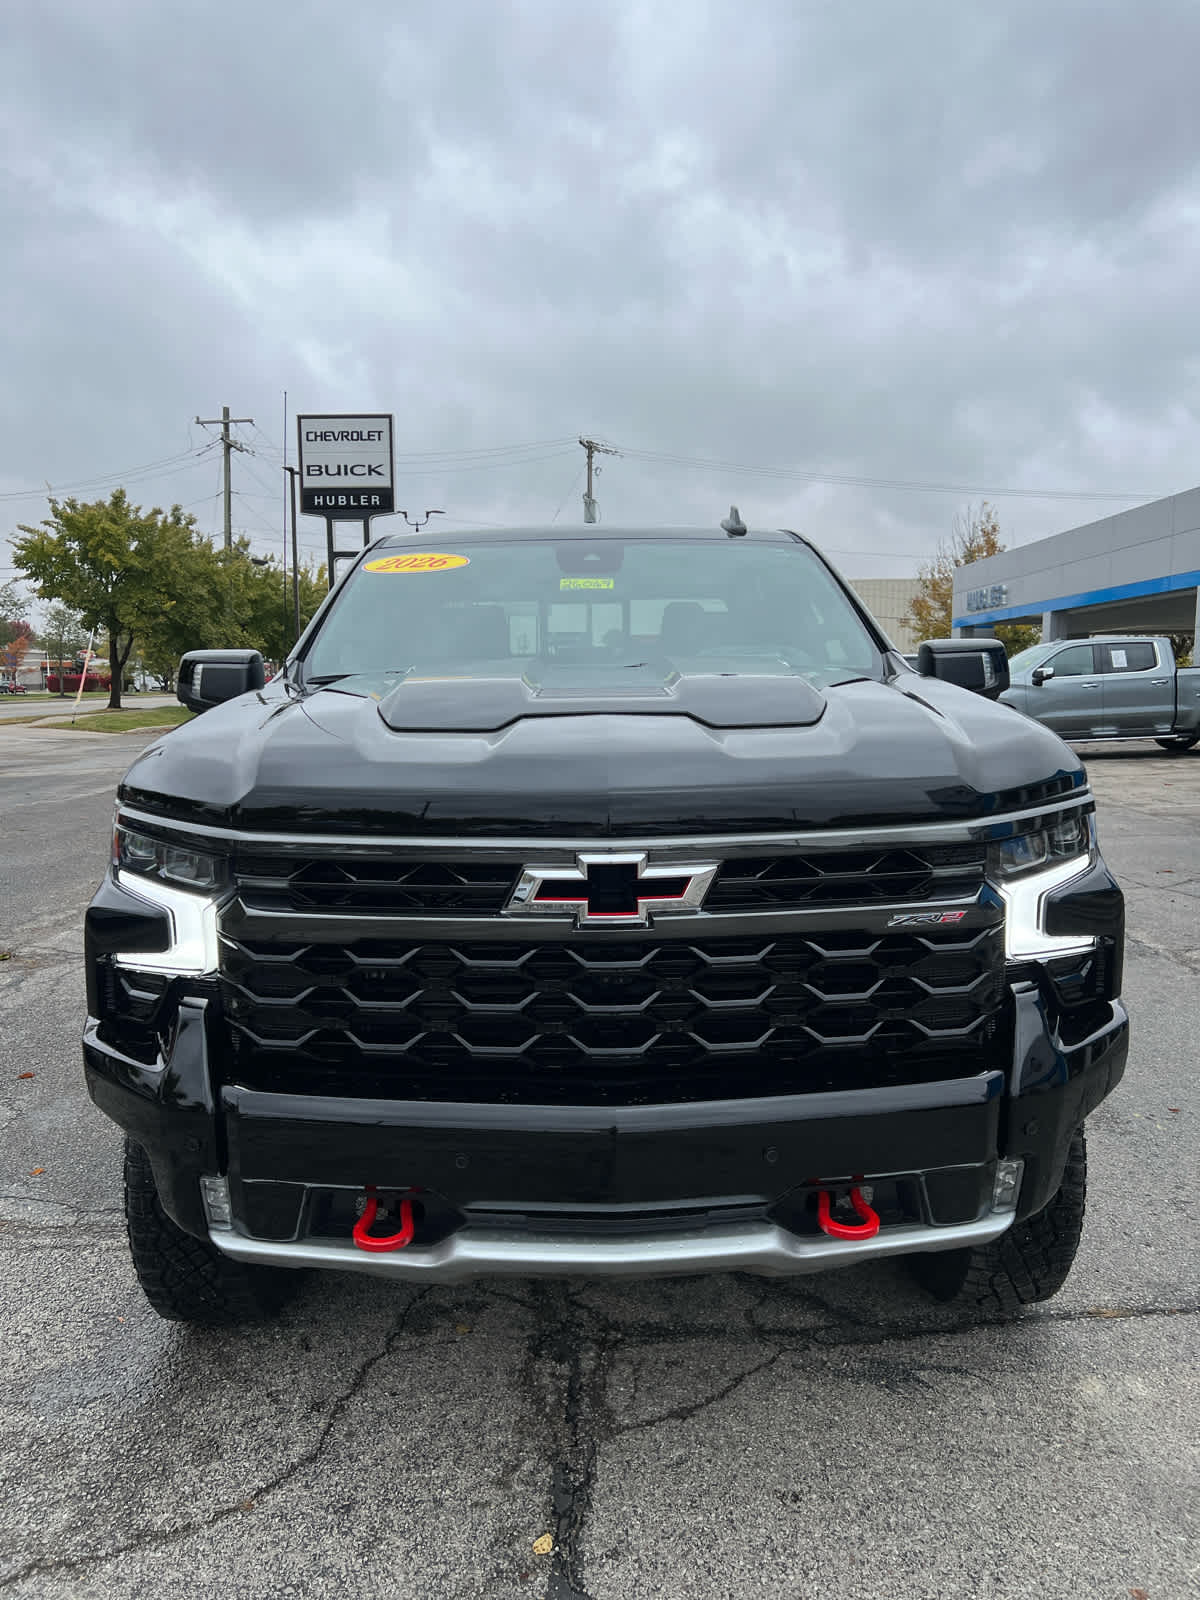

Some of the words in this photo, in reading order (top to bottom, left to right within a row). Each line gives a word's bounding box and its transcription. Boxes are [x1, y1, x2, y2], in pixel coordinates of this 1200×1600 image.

[305, 430, 384, 442] CHEVROLET
[305, 463, 385, 477] BUICK
[314, 495, 381, 506] HUBLER
[375, 556, 450, 570] 2026
